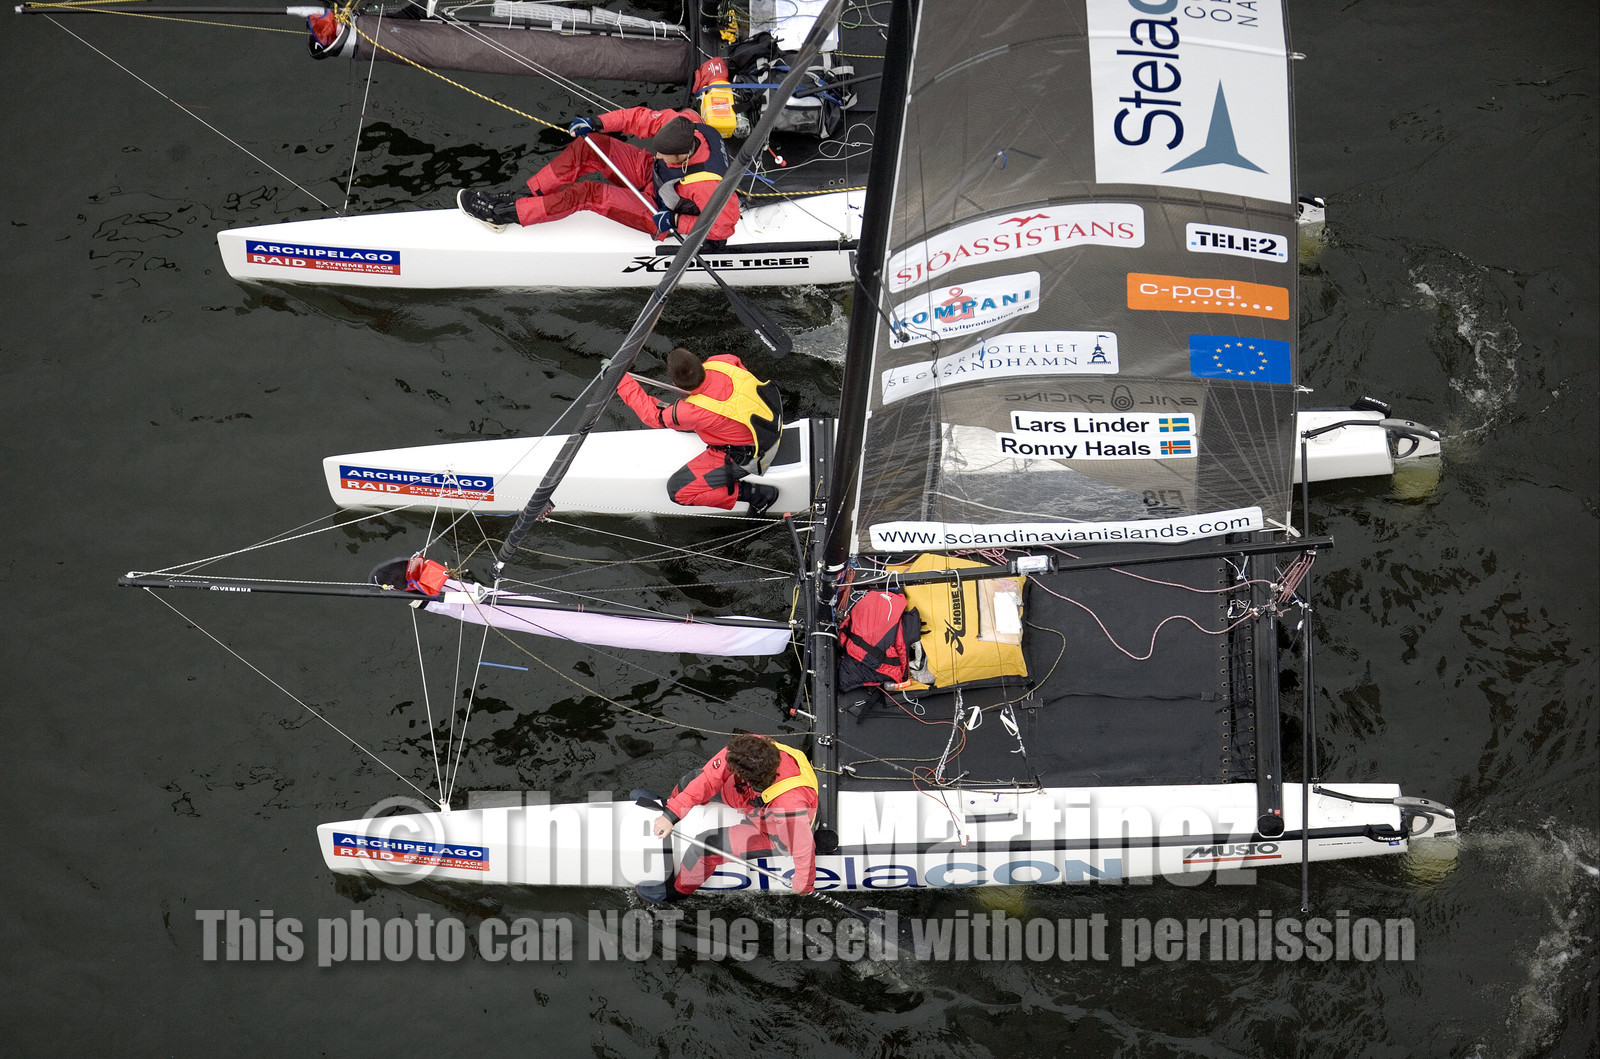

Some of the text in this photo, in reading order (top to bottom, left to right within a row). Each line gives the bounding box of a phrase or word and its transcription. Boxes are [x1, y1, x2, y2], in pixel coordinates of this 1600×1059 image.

[253, 244, 393, 262] ARCHIPELAGO
[253, 255, 307, 268] RAID
[315, 260, 363, 269] EXTREME
[739, 257, 809, 266] TIGER
[896, 221, 1134, 285] SJÖASSISTANS
[943, 356, 1079, 378] SANDHAMN
[1015, 415, 1150, 433] Lars Linder
[1001, 437, 1151, 458] Ronny Haals
[347, 469, 486, 487] ARCHIPELAGO
[347, 480, 400, 492] RAID
[878, 516, 1250, 544] www.scandinavianislands.com
[951, 590, 961, 626] HOBIE
[340, 837, 483, 858] ARCHIPELAGO
[340, 848, 395, 860] RAID
[403, 854, 453, 864] EXTREME
[1184, 842, 1280, 858] MUSTO
